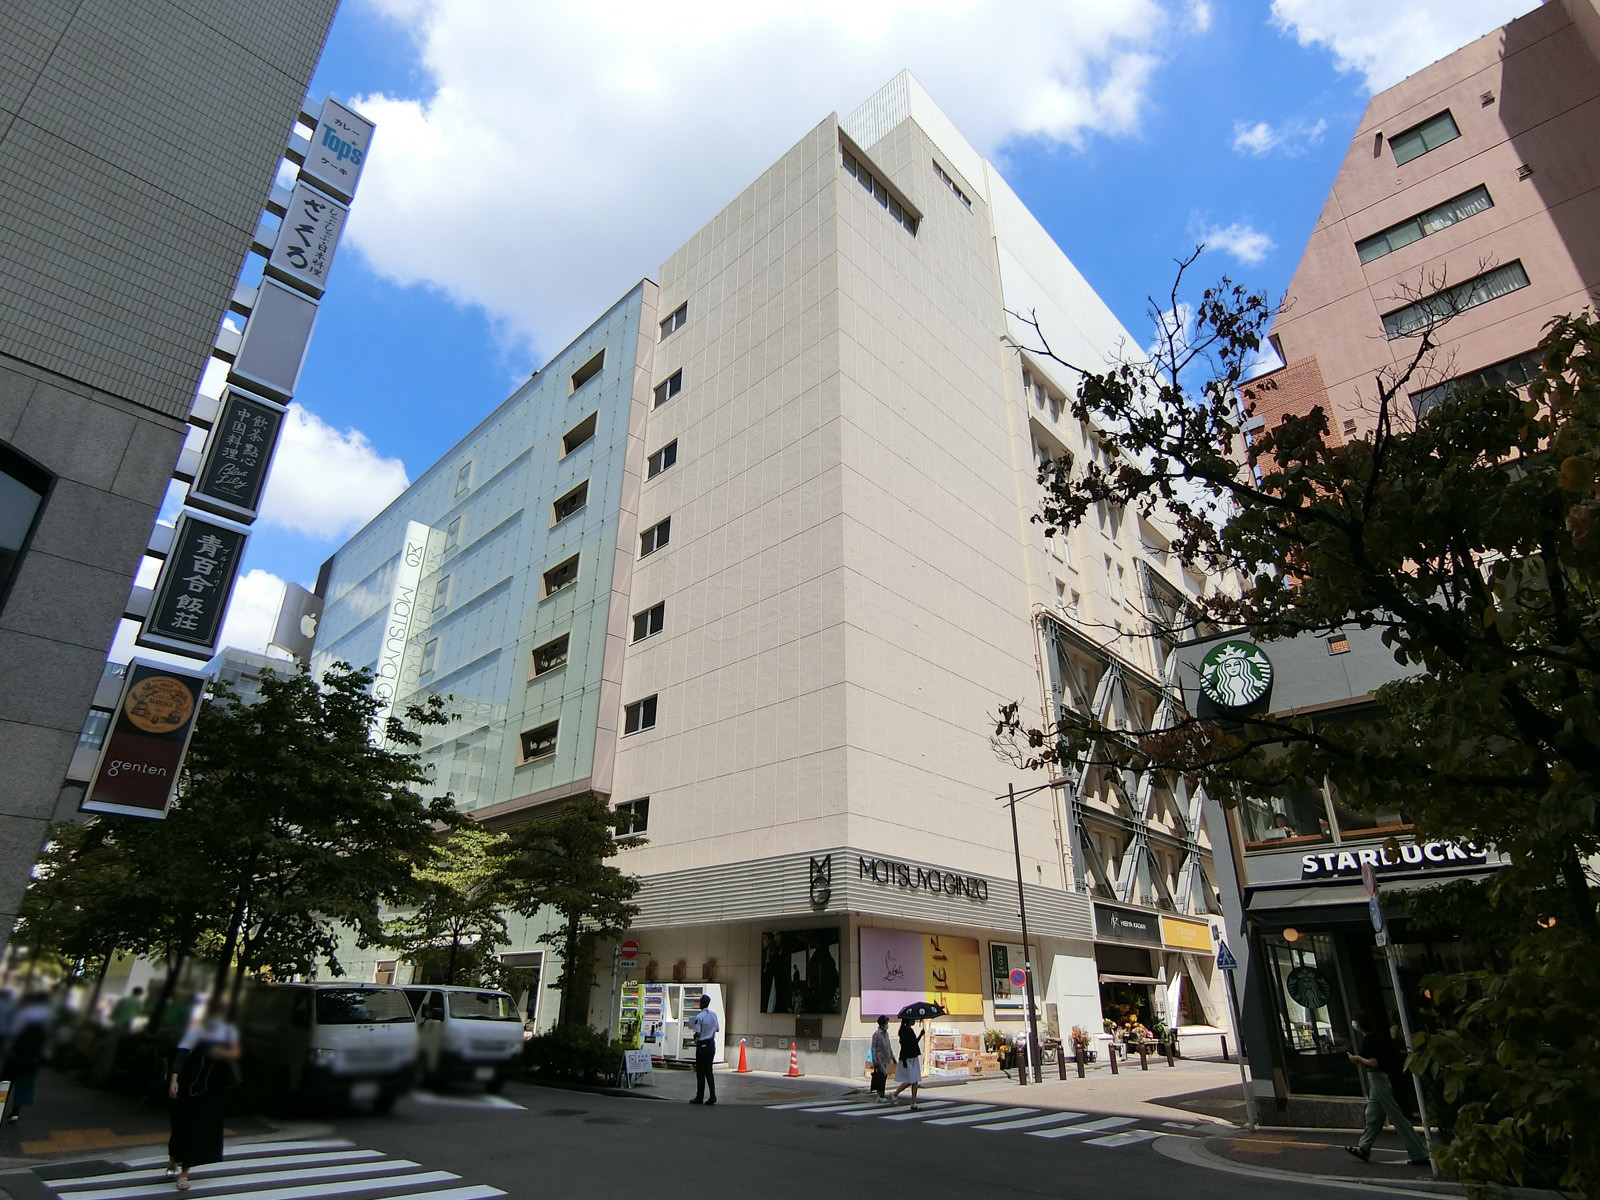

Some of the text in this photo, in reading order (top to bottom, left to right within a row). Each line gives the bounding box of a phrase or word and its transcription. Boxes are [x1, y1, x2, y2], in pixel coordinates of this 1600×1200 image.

[334, 118, 360, 136] カレー
[321, 157, 348, 176] ケーキ
[222, 408, 251, 460] 中国料理
[218, 463, 248, 476] Blue
[215, 475, 248, 489] Lily
[170, 534, 224, 631] 青百合飯荘
[108, 759, 167, 777] genten
